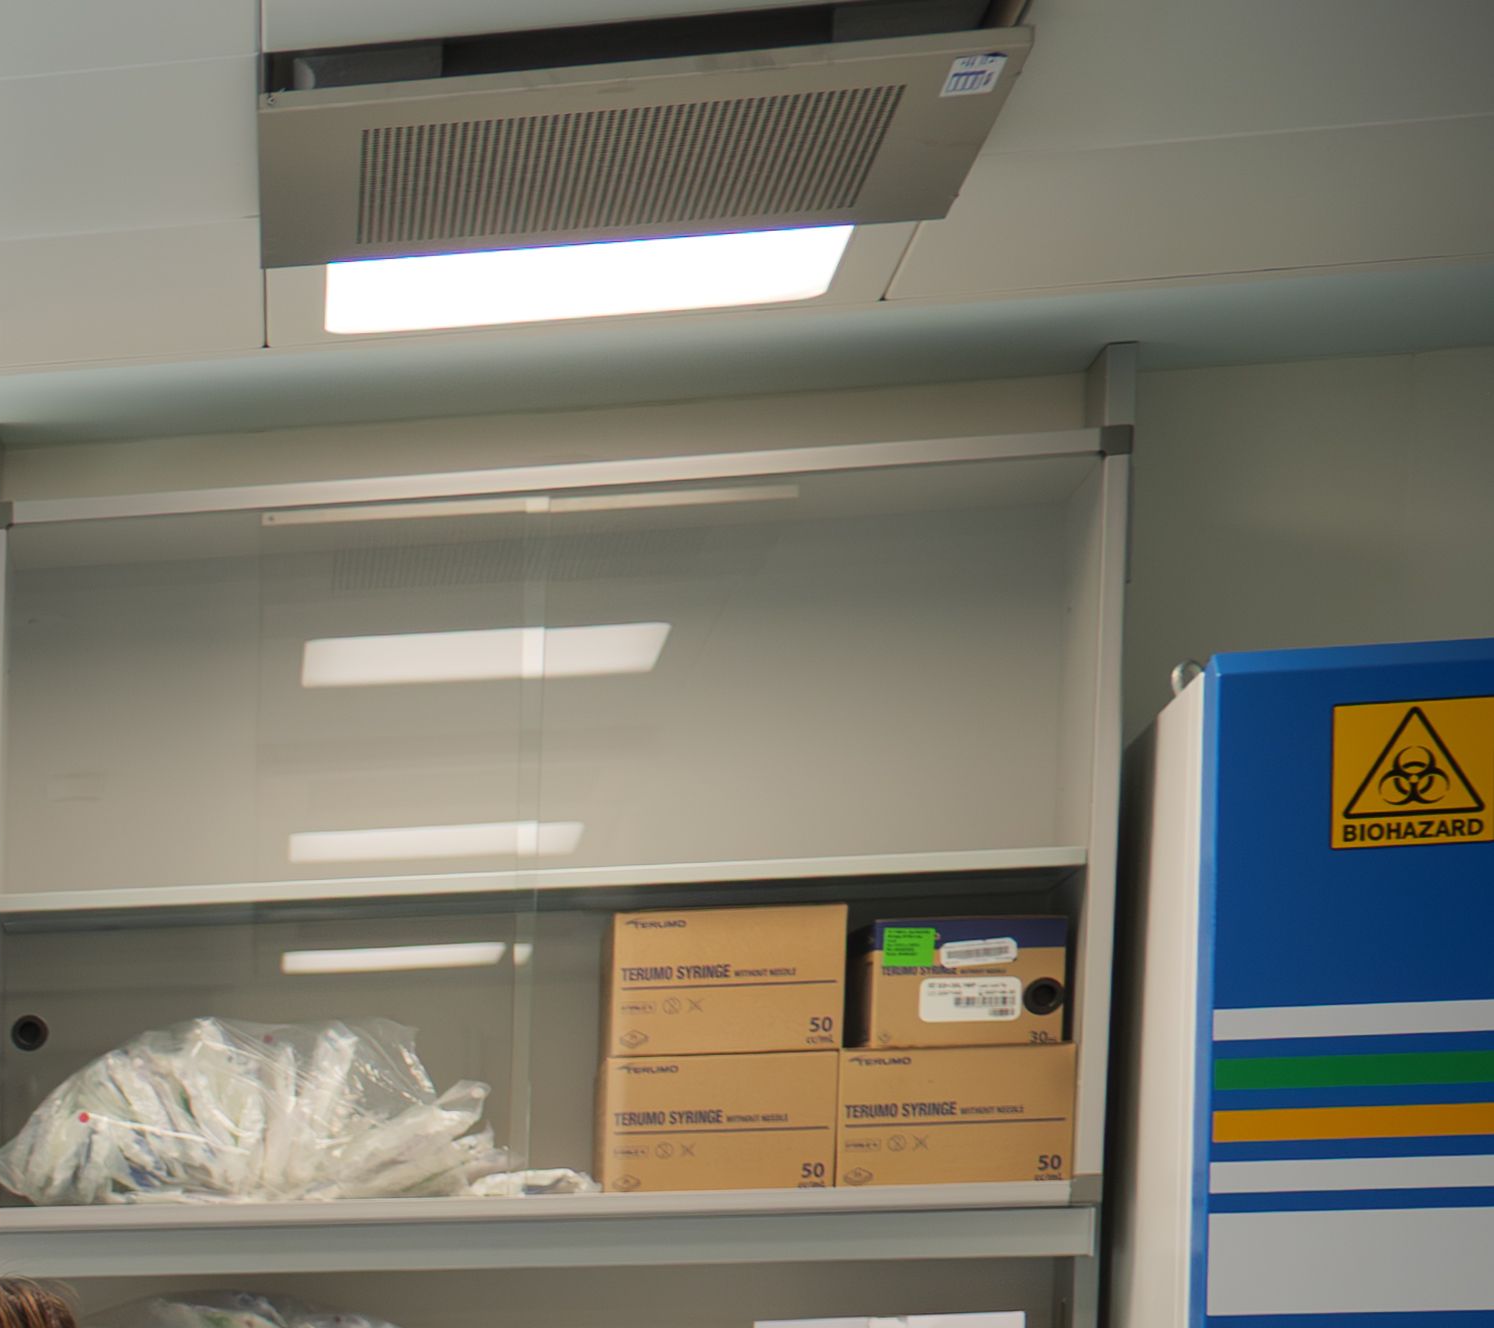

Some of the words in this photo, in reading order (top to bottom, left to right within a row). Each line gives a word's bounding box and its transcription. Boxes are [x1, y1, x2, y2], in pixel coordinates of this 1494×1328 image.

[1342, 818, 1484, 843] BIOHAZARD
[621, 966, 673, 981] TERUMO
[677, 964, 731, 979] SYRINGE
[809, 1017, 833, 1032] 50
[614, 1112, 665, 1126] TERUMO
[670, 1110, 723, 1125] SYRINGE
[845, 1104, 898, 1119] TERUMO
[902, 1102, 957, 1117] SYRINGE
[801, 1163, 825, 1178] 50
[1038, 1155, 1062, 1170] 50
